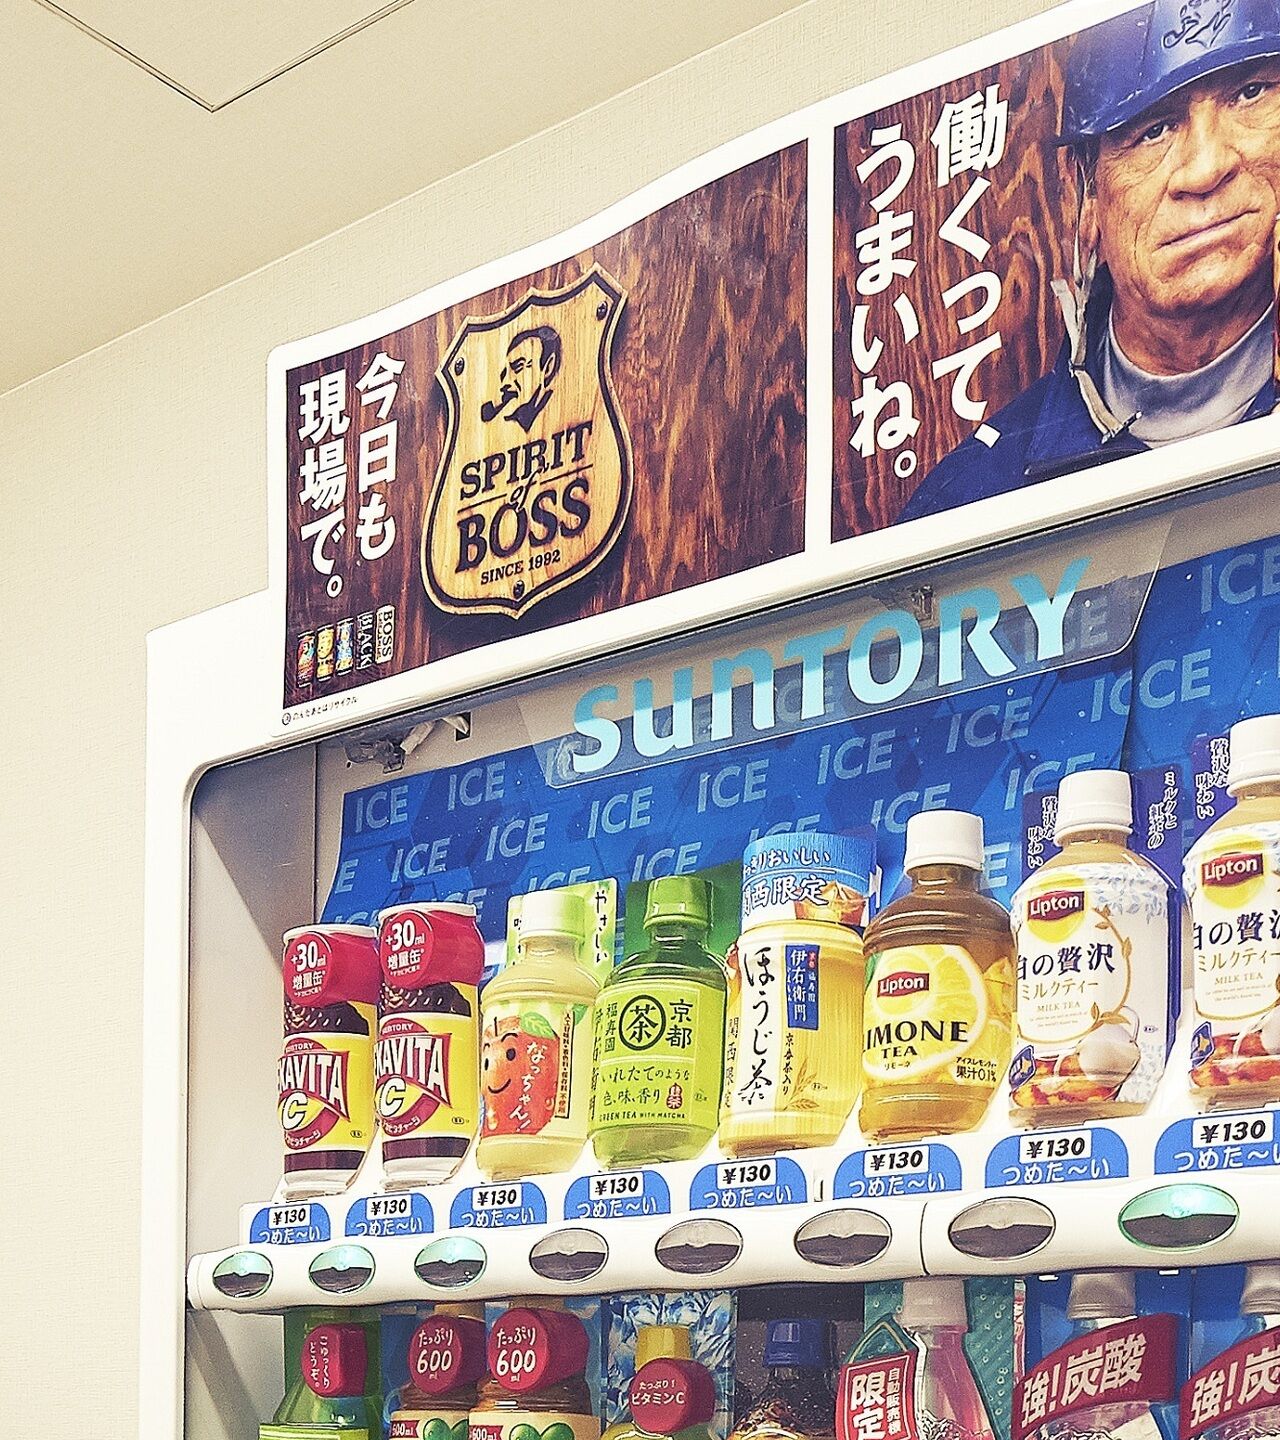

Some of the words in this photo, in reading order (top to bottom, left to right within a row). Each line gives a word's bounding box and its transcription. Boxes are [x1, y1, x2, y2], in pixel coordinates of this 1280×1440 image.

[931, 83, 1007, 448] 働くって、
[851, 124, 919, 480] うまいね。
[355, 351, 405, 564] 今日も
[459, 420, 594, 502] SPIRIT
[297, 368, 347, 598] 現場で。
[455, 477, 591, 573] BOSS
[480, 558, 524, 586] SINCE
[526, 547, 562, 576] 1992
[571, 556, 1091, 774] SUNTORY
[945, 697, 1029, 753] ICE
[355, 785, 409, 834] ICE
[587, 787, 652, 839] ICE
[1204, 859, 1258, 881] Lipton
[1030, 894, 1080, 917] Lipton
[880, 977, 924, 995] Lipton
[1021, 979, 1099, 1000] ミルクティー
[1214, 974, 1240, 985] MILK
[1243, 972, 1263, 982] TEA
[665, 999, 693, 1049] 京都
[739, 946, 776, 1106] ほうじ茶
[881, 1046, 918, 1058] TEA
[1026, 1138, 1086, 1158] ¥130
[595, 1176, 641, 1195] ¥130
[272, 1210, 307, 1225] ¥130
[498, 1327, 536, 1349] たっぷり
[416, 1347, 452, 1374] 600
[496, 1350, 535, 1375] 600
[630, 1390, 686, 1407] ビタミンC
